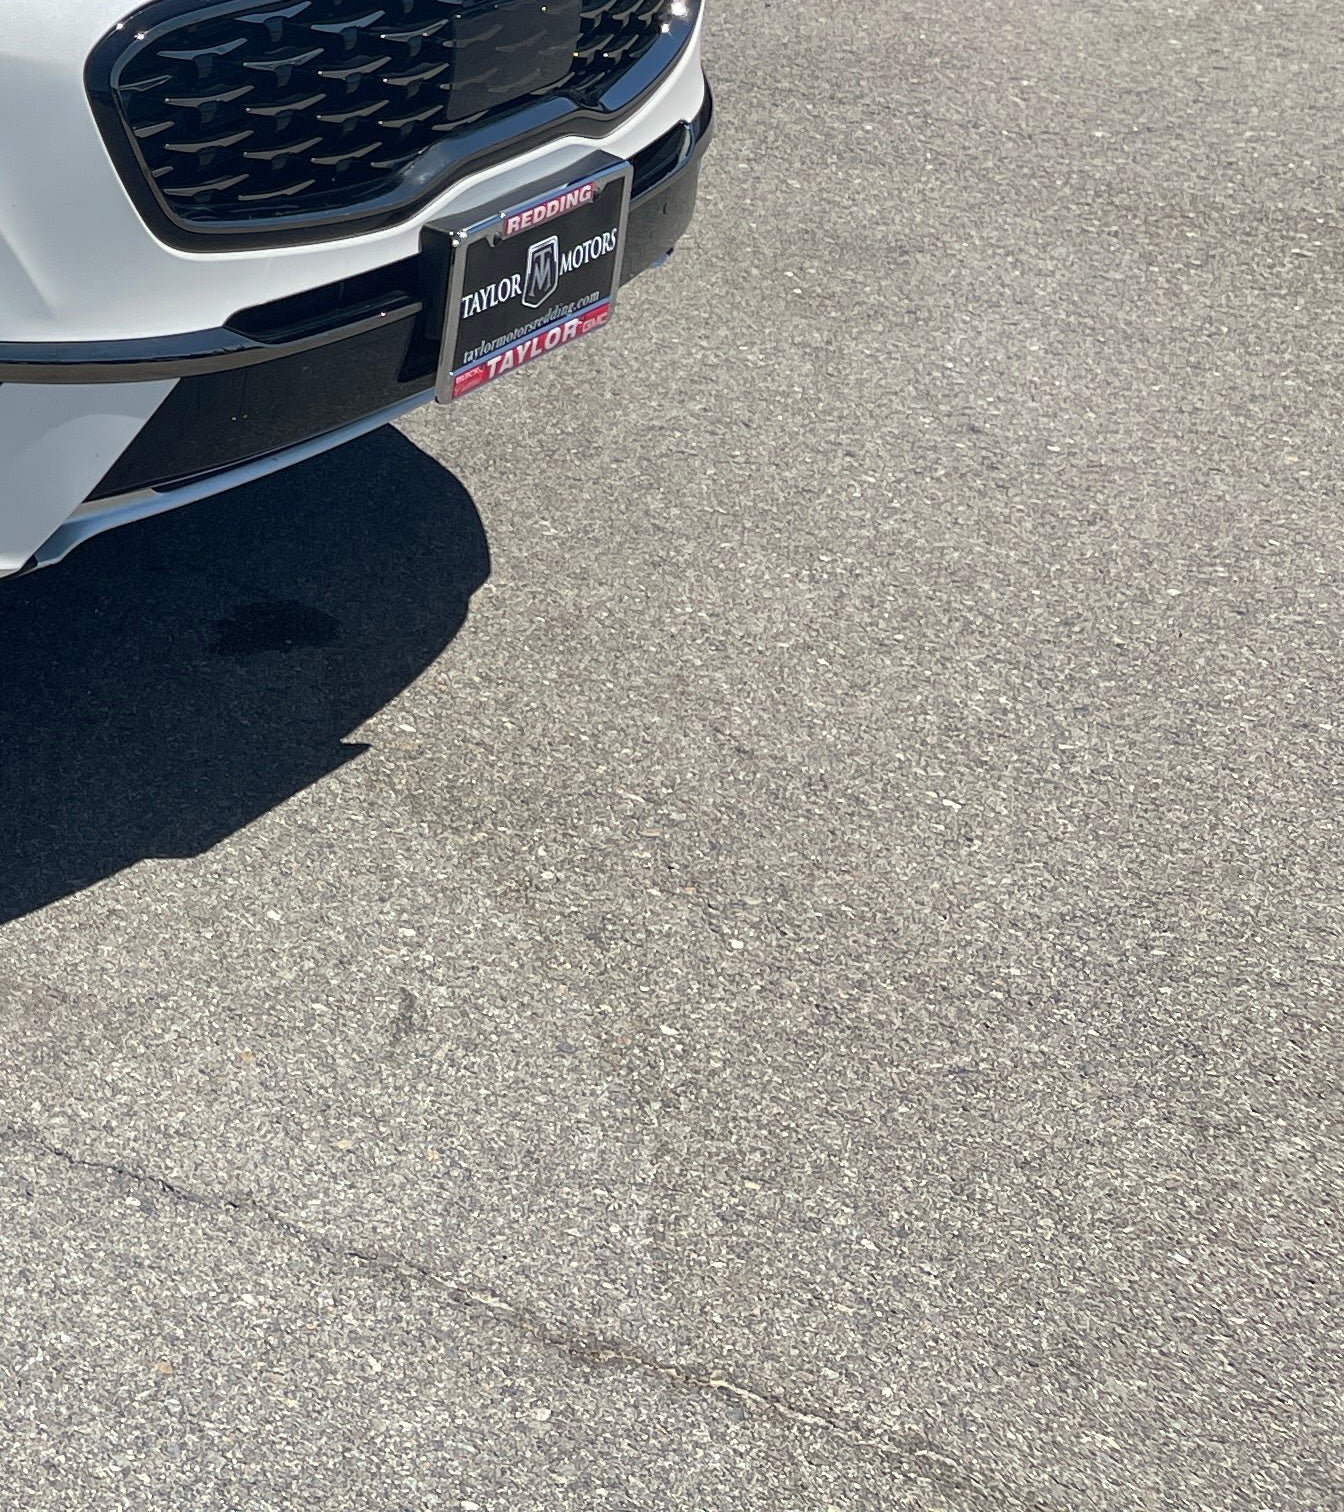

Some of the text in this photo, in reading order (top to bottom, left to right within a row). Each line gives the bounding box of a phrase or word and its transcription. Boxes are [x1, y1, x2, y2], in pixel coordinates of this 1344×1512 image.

[507, 184, 594, 235] REDDING
[462, 228, 618, 319] TAYLOR MOTORS
[463, 290, 600, 364] taylormotorsredding.com
[486, 319, 580, 379] TAYLOR
[582, 312, 609, 334] GMC
